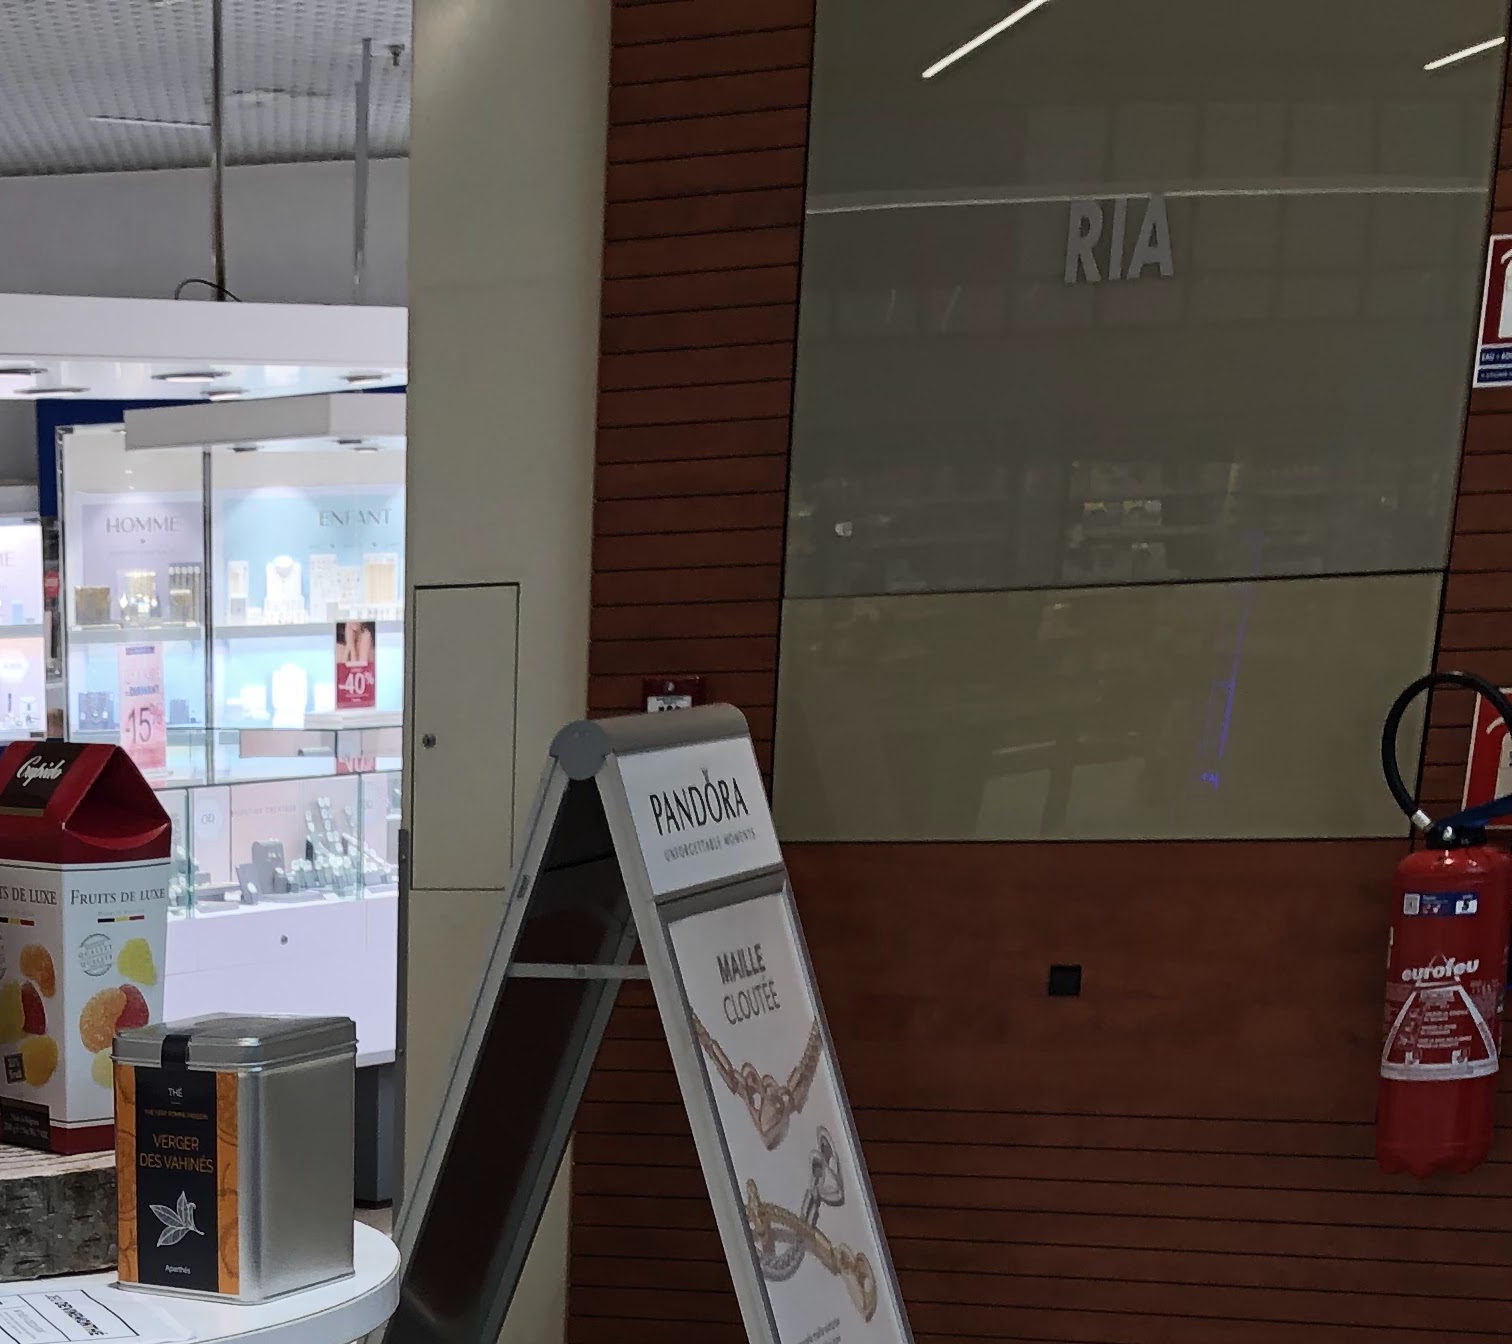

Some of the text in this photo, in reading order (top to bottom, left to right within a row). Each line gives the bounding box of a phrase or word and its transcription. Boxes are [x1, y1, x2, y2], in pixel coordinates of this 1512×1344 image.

[1065, 194, 1174, 283] RIA
[106, 515, 181, 534] HOMME
[319, 507, 392, 527] ENFANT
[16, 755, 66, 787] Cupido
[650, 774, 750, 836] PANDORA
[11, 887, 28, 902] DE
[29, 889, 58, 905] LUXE
[70, 888, 166, 905] FRUITS DE LUXE
[717, 943, 766, 984] MAILLE
[1402, 957, 1480, 982] eurofeu
[724, 974, 781, 1025] CLOUTÉE
[168, 1086, 184, 1098] THÉ
[152, 1133, 199, 1151] VERGER
[139, 1153, 214, 1174] DES VAHINÉS
